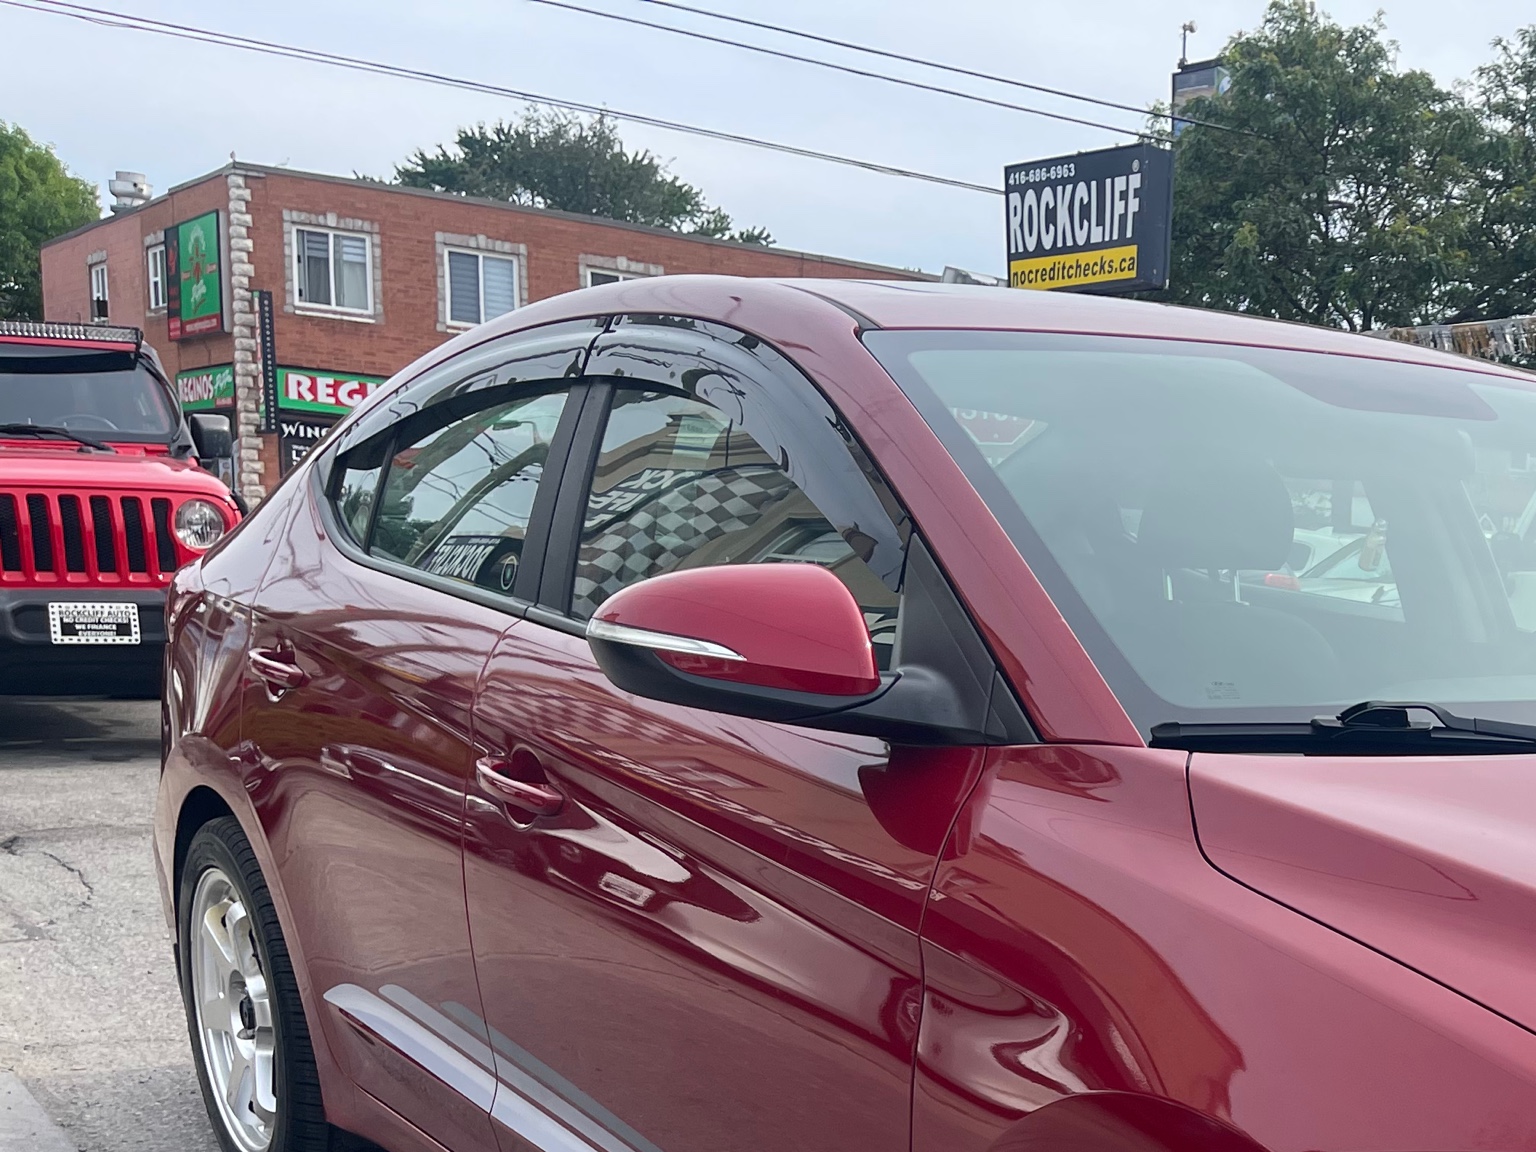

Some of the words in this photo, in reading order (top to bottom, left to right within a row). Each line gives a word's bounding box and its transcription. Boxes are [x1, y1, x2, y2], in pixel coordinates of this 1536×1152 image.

[1008, 163, 1076, 186] 416-686-6963
[1009, 172, 1142, 254] ROCKCLIFF
[1012, 255, 1136, 286] nocreditchecks.ca
[178, 373, 214, 402] REGINOS
